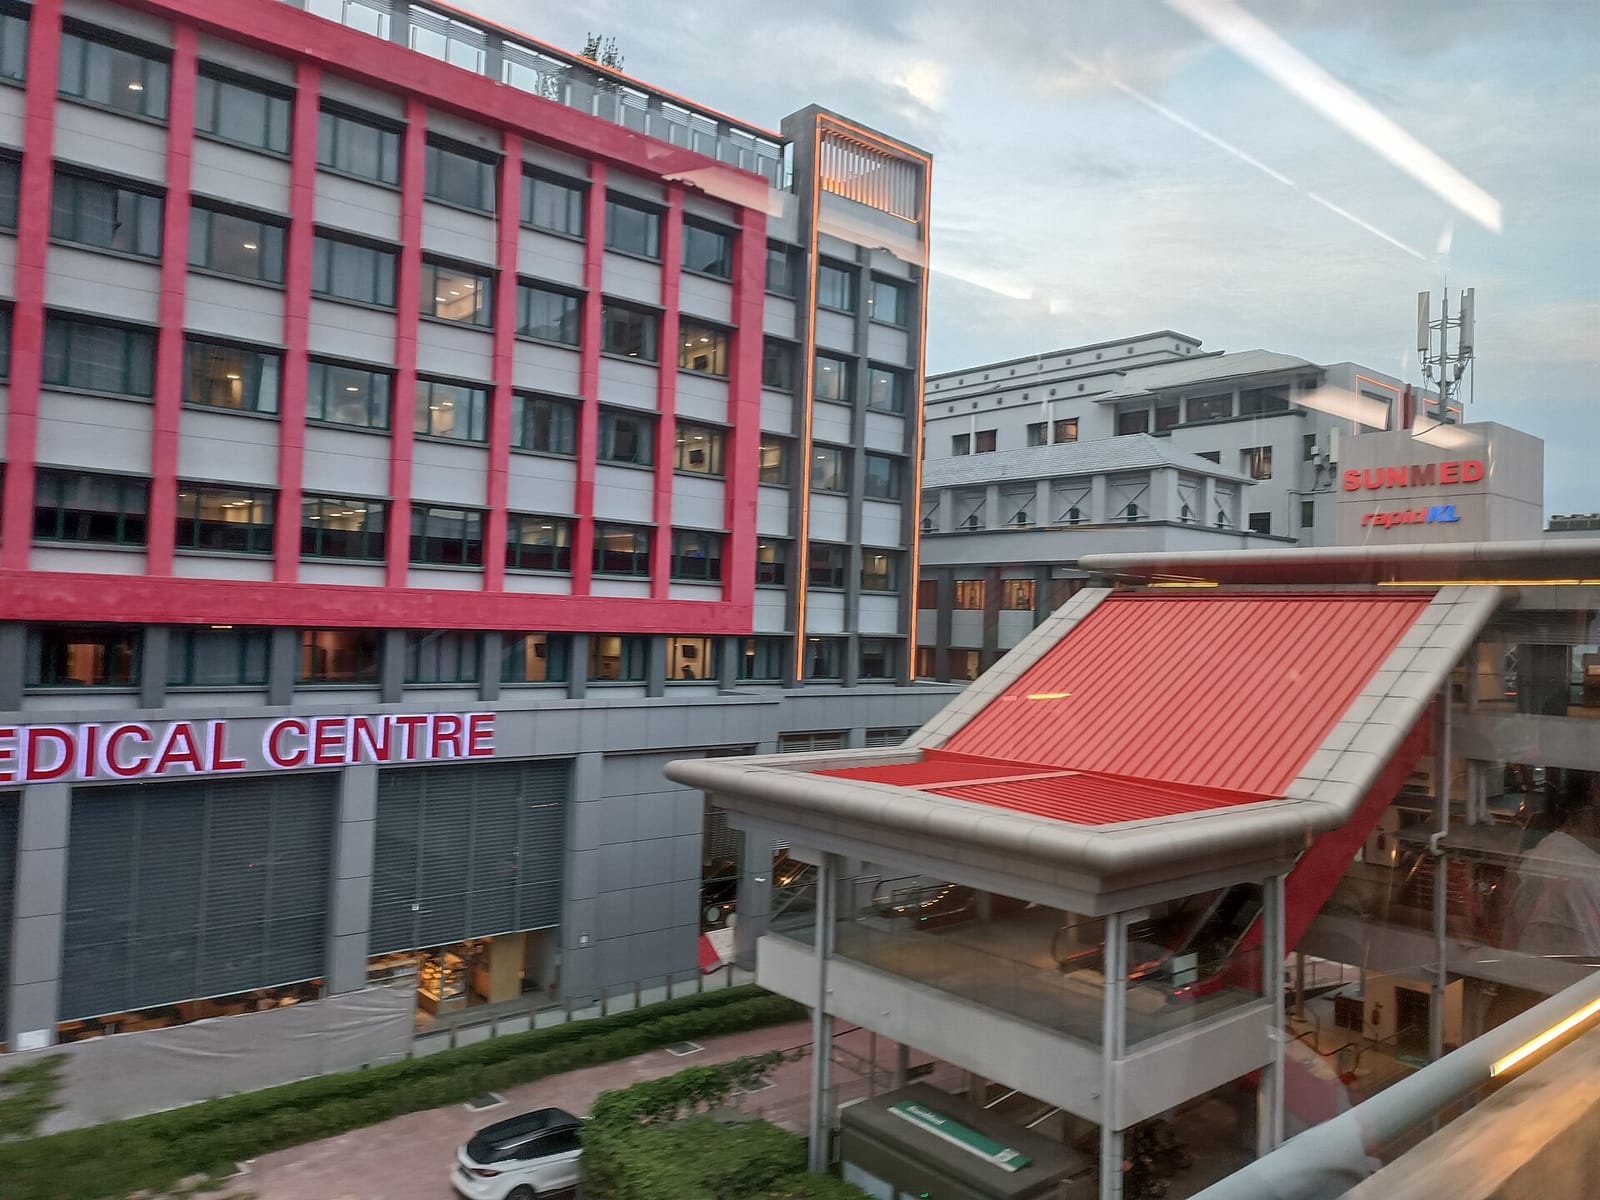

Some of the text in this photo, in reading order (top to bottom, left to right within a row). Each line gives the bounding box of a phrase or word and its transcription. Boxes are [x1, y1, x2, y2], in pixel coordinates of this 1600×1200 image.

[1343, 459, 1485, 491] SUNMED
[1362, 504, 1461, 529] rapidKL
[264, 713, 496, 768] CENTRE
